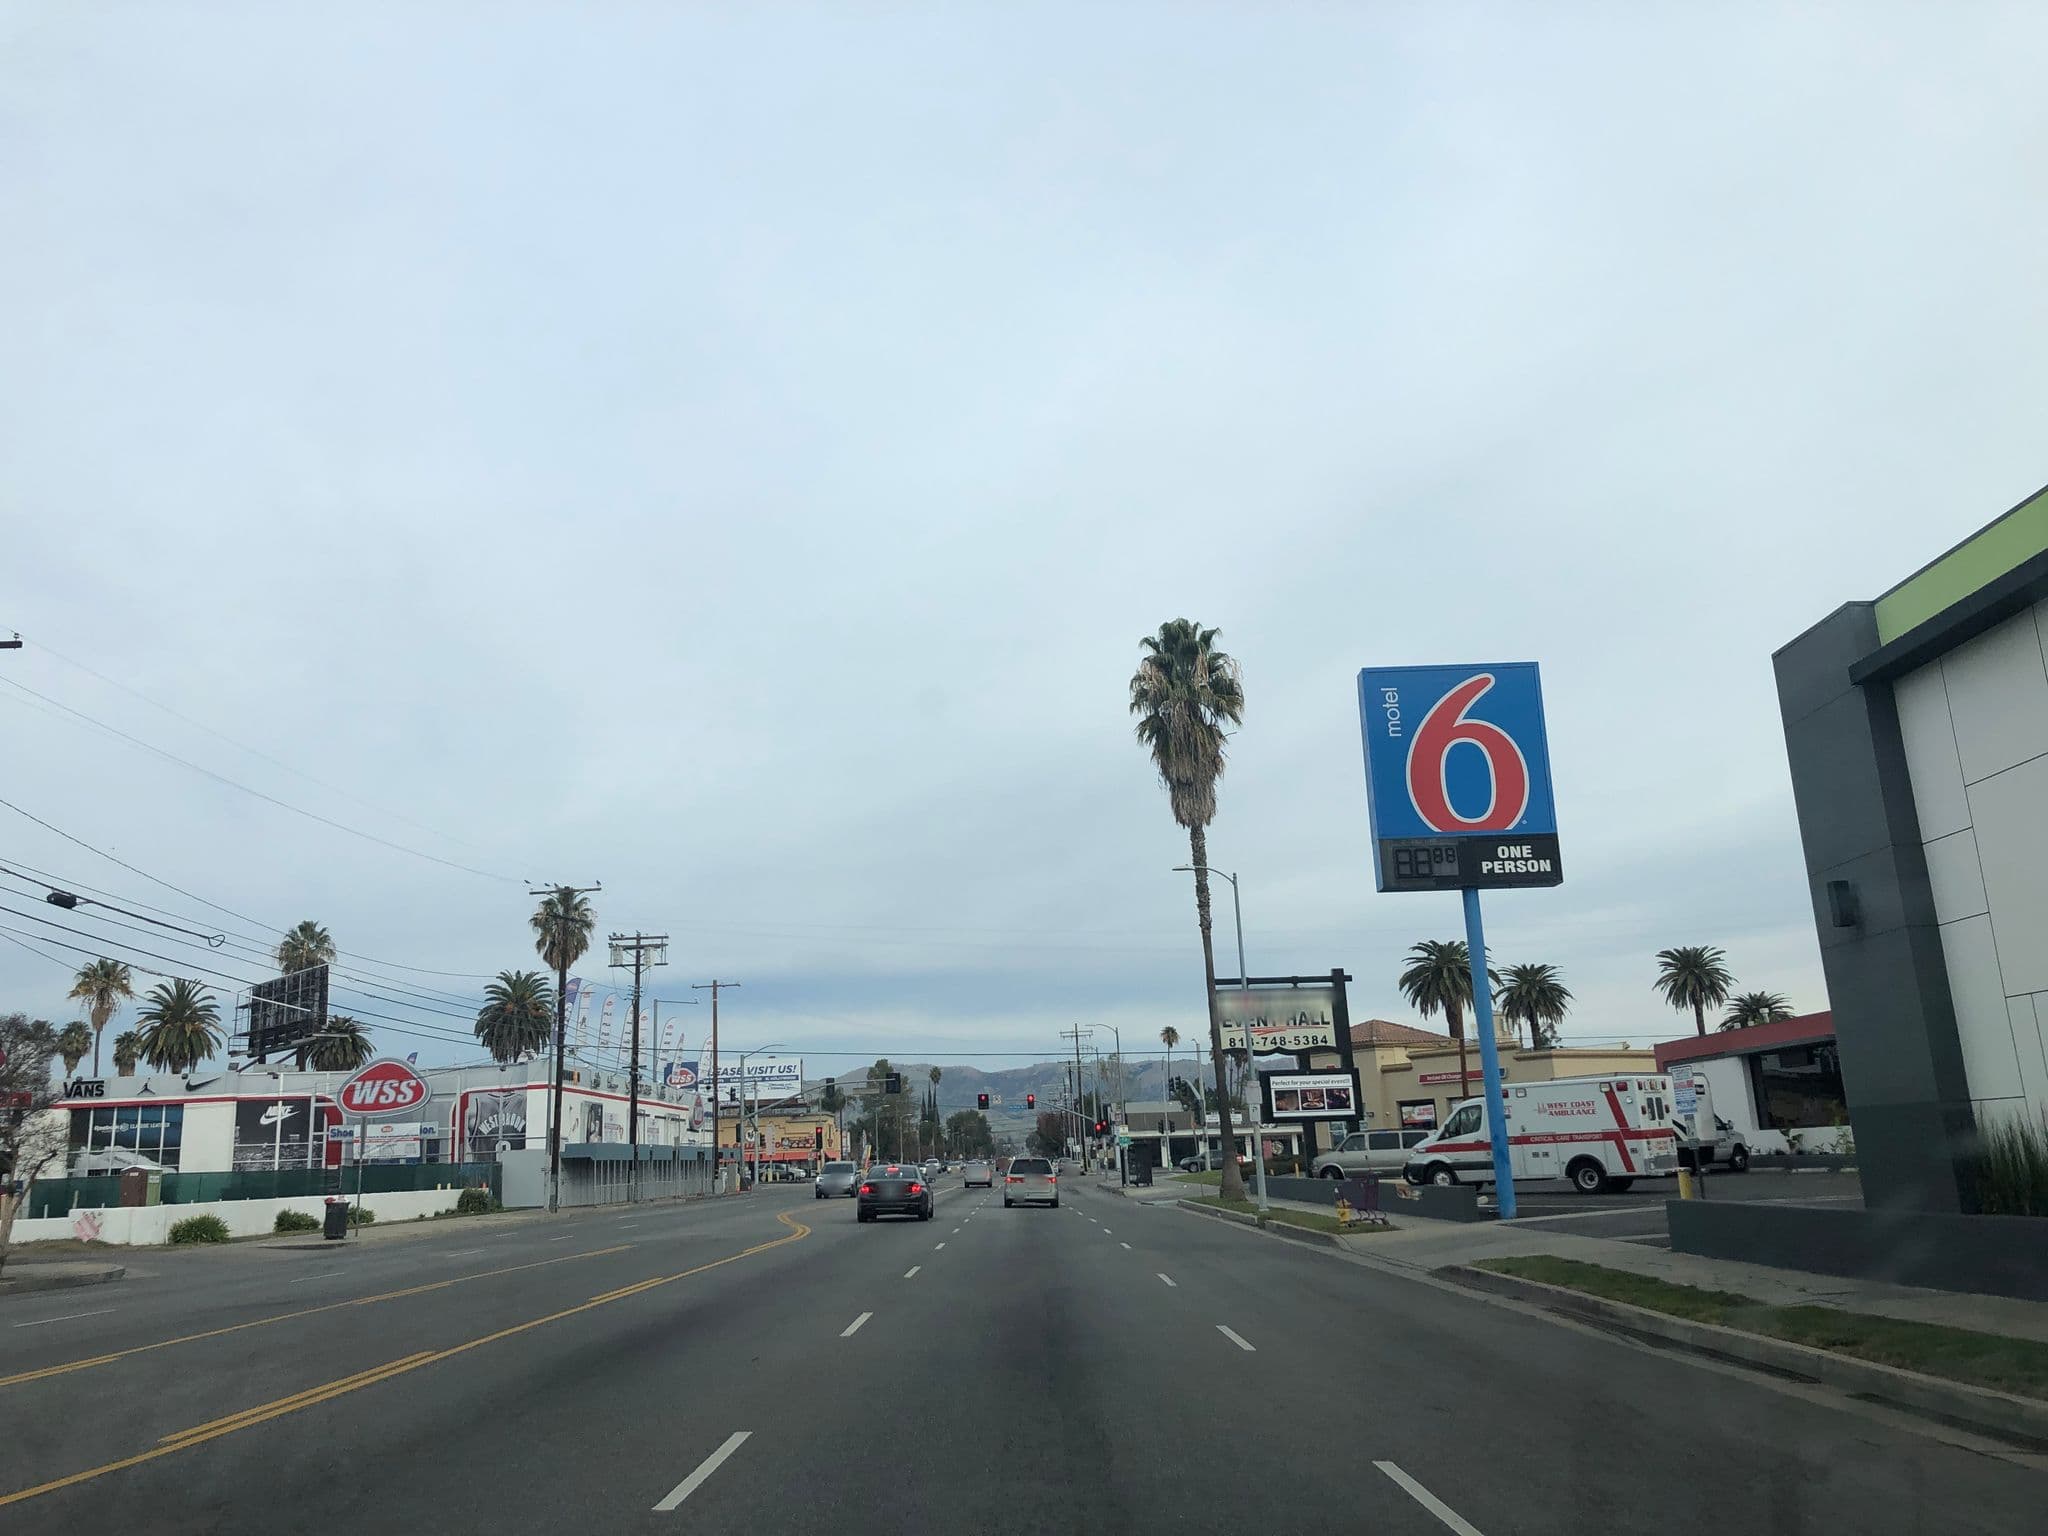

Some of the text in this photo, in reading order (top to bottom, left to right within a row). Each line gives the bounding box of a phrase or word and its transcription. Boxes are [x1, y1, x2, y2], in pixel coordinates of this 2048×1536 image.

[1380, 687, 1402, 737] motel
[1405, 672, 1530, 832] 6
[1497, 845, 1533, 859] ONE
[1481, 859, 1552, 874] PERSON
[747, 1065, 776, 1075] VISIT
[777, 1064, 797, 1074] US!
[63, 1080, 105, 1098] VANS
[351, 1079, 417, 1105] WSS
[1570, 1100, 1596, 1108] COAST
